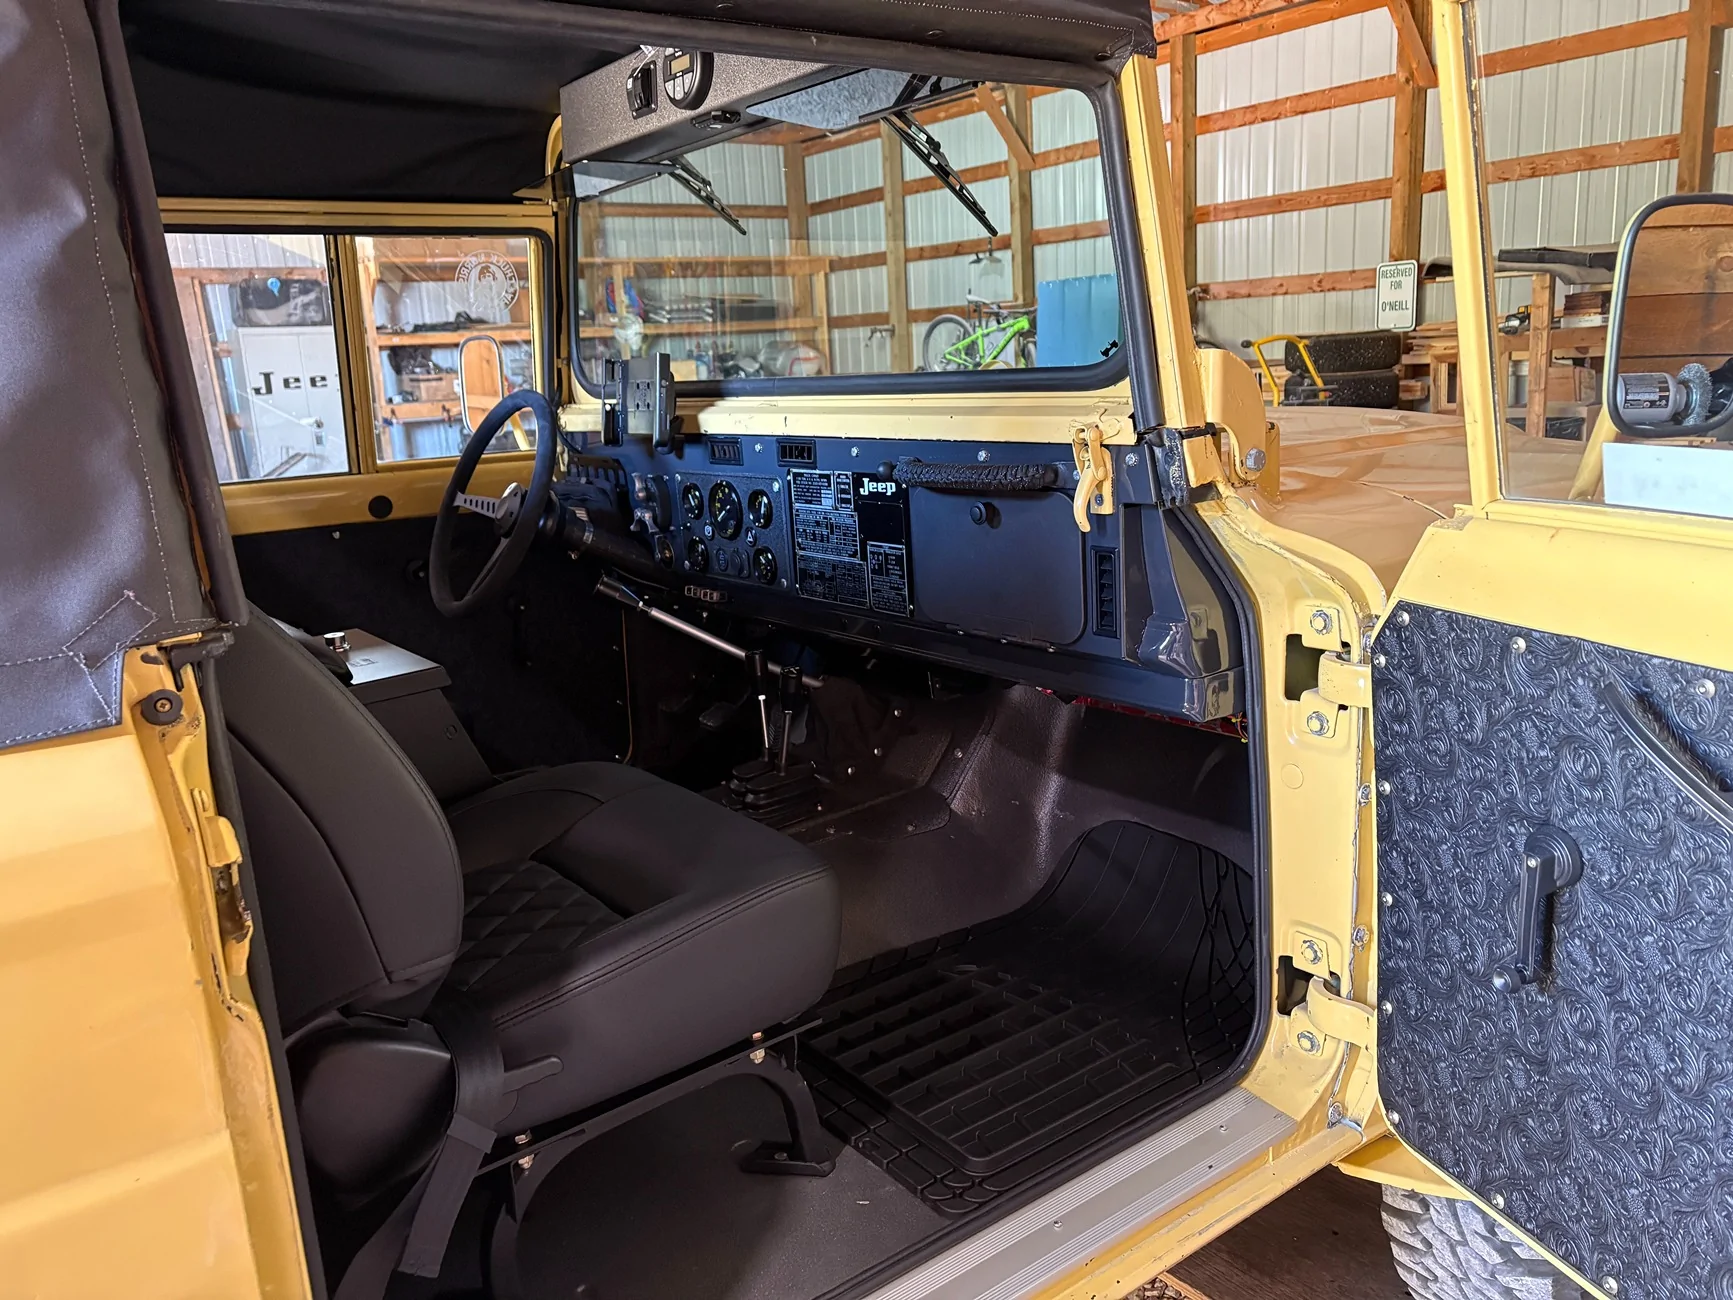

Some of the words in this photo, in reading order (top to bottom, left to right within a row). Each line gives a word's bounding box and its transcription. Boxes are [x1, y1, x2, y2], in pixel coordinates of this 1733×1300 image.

[1381, 267, 1412, 279] RESERVED
[1390, 280, 1402, 290] FOR
[1381, 300, 1409, 312] O'NEILL
[252, 371, 339, 395] Jee
[859, 477, 897, 496] Jeep
